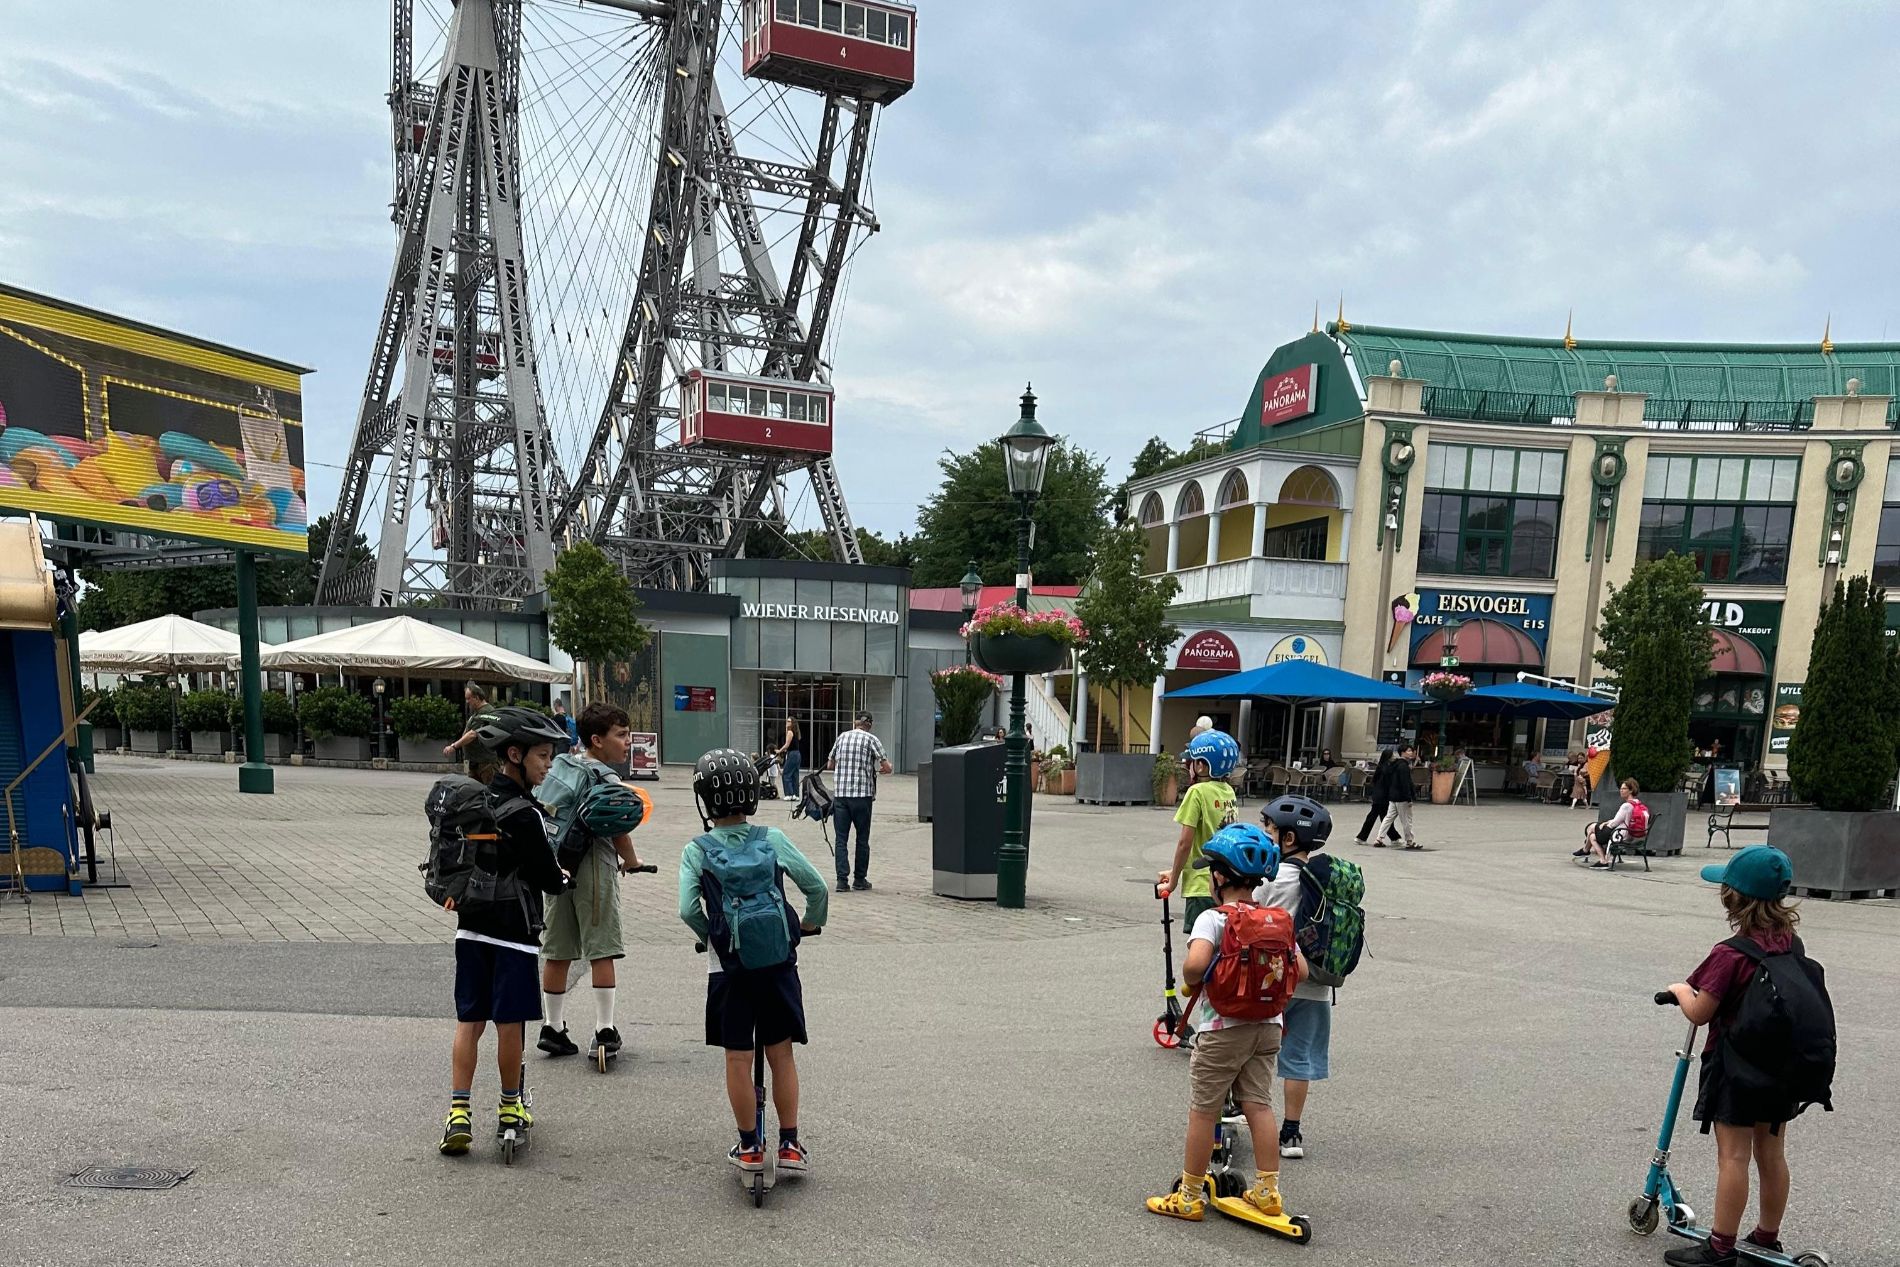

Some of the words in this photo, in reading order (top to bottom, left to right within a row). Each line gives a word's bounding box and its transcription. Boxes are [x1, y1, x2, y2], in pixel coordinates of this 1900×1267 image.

[840, 46, 846, 58] 4
[1264, 389, 1306, 412] PANORAMA
[765, 427, 772, 438] 2
[1438, 594, 1530, 615] EISVOGEL
[743, 603, 808, 619] WIENER
[814, 605, 899, 624] RIESENRAD
[1416, 615, 1443, 625] CAFE
[1523, 619, 1545, 629] EIS
[1738, 627, 1772, 635] TAKEOUT
[1185, 648, 1234, 659] PANORAMA
[1192, 745, 1216, 755] woom
